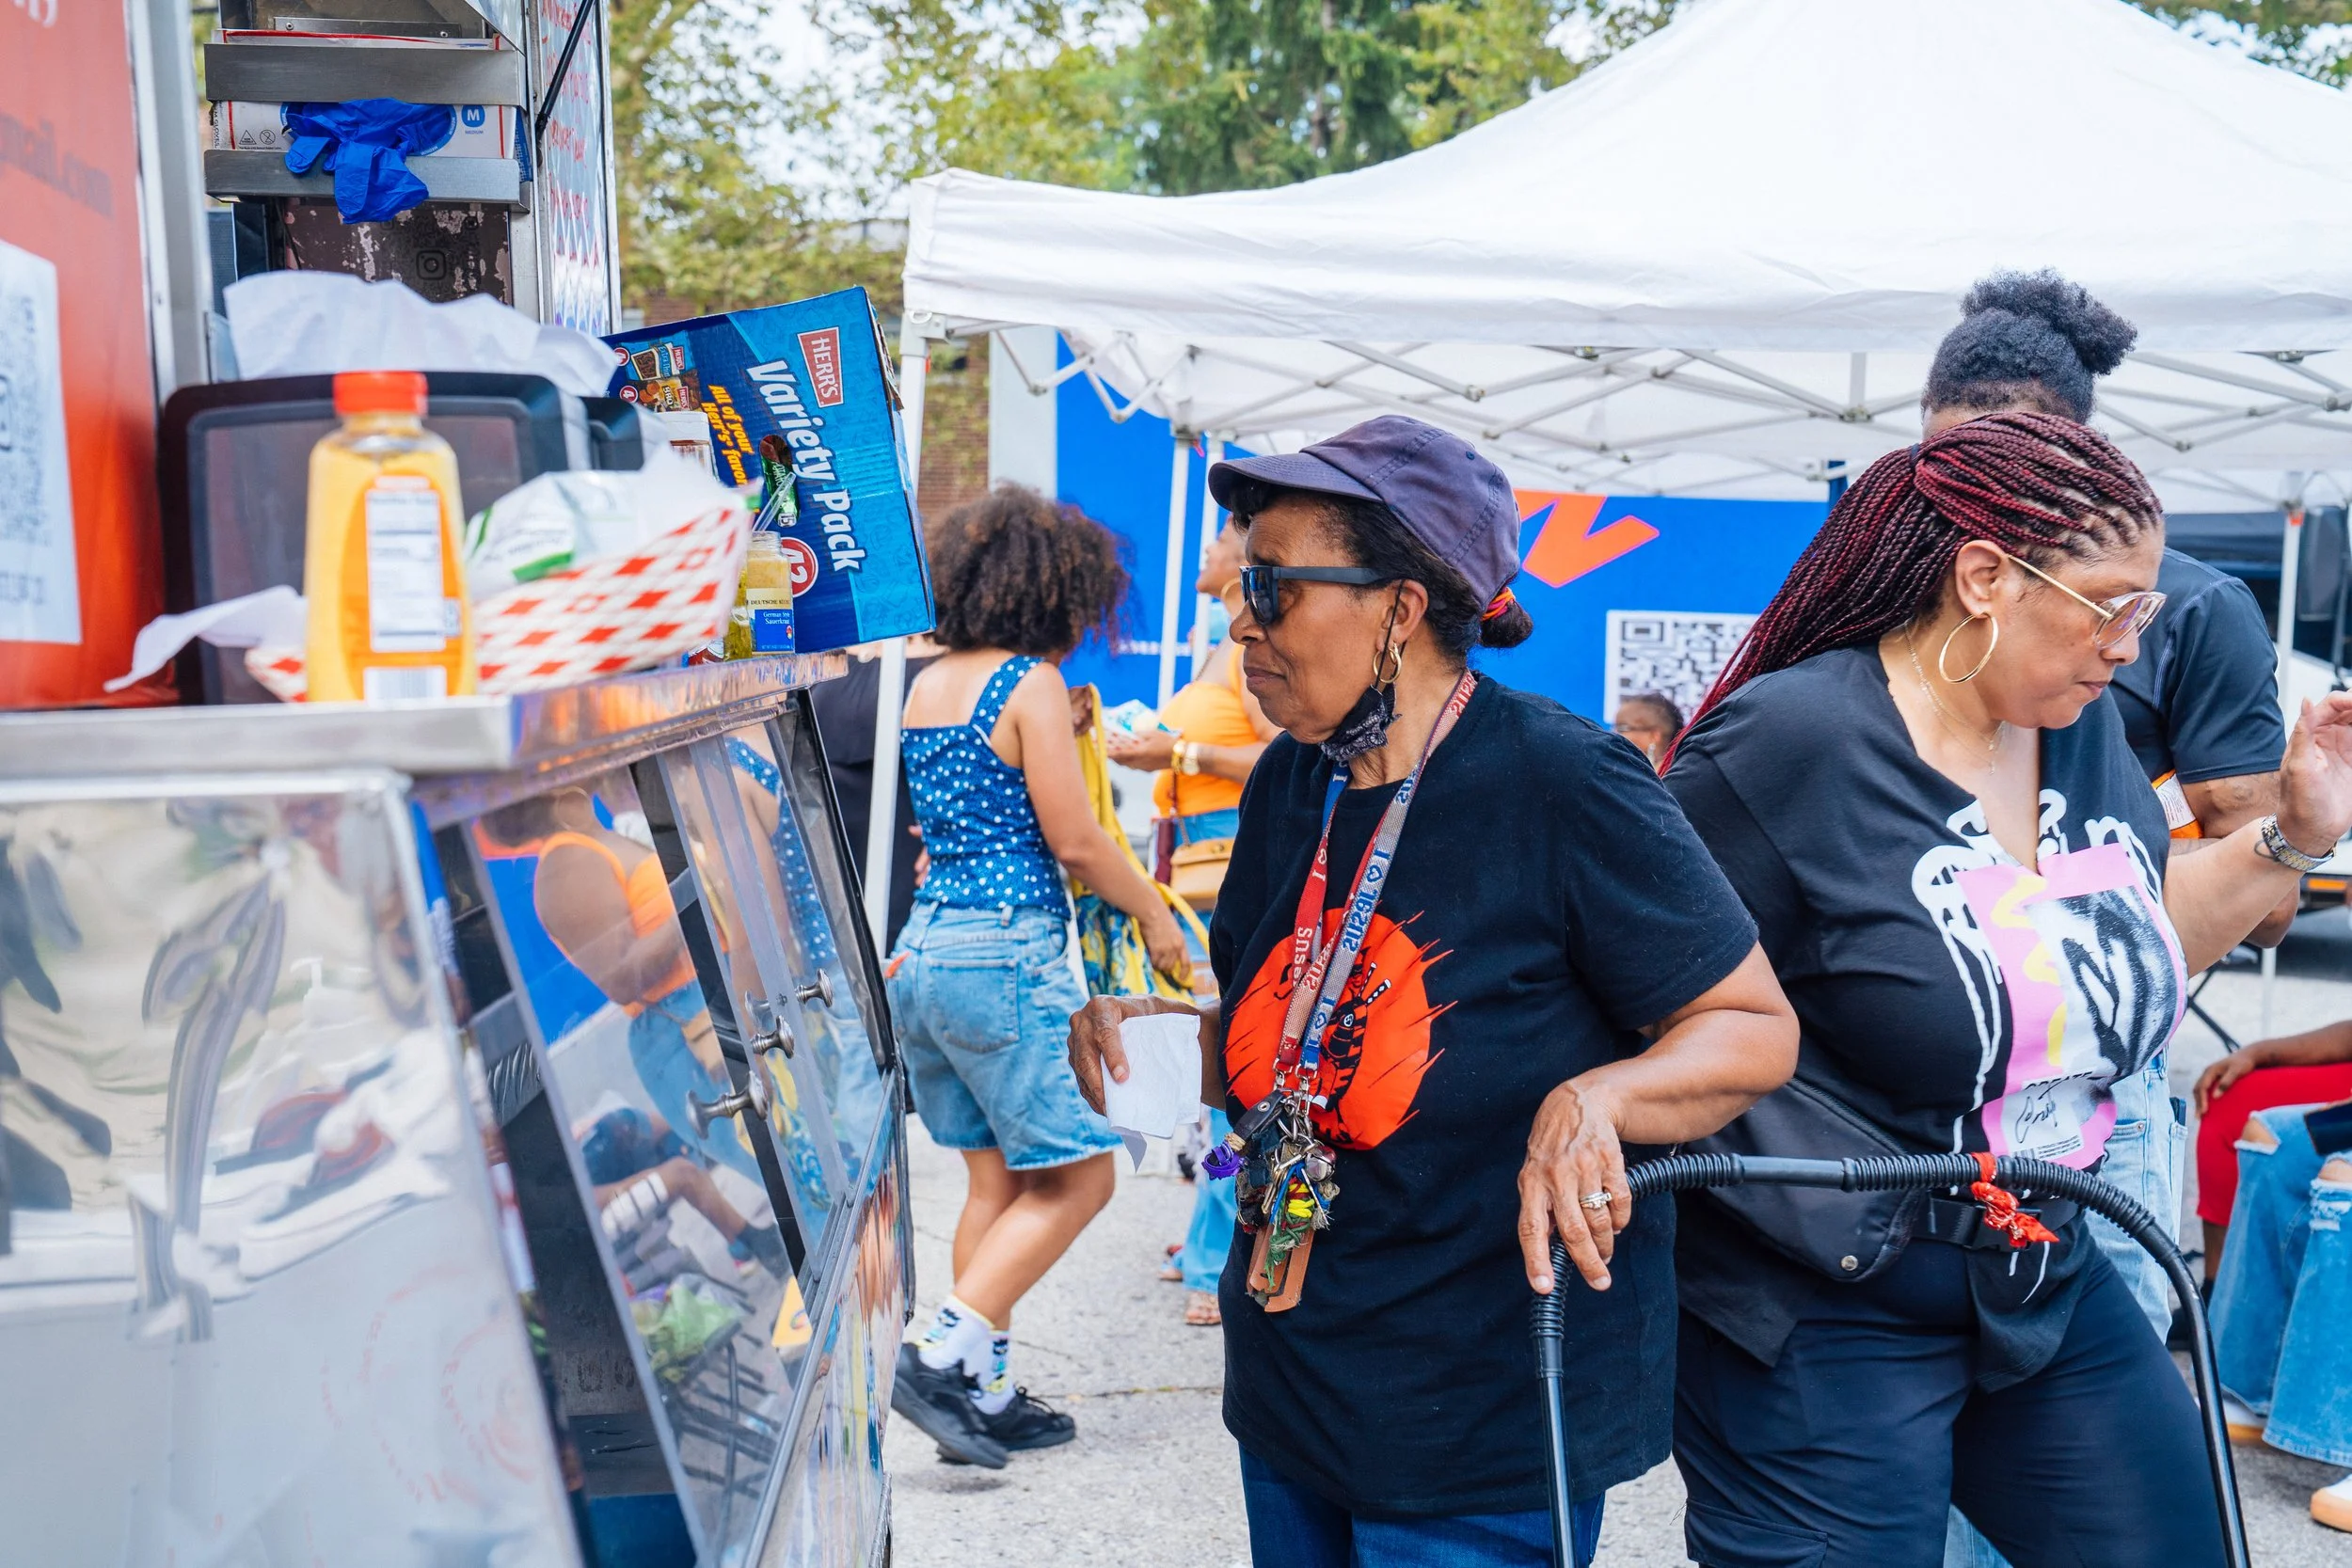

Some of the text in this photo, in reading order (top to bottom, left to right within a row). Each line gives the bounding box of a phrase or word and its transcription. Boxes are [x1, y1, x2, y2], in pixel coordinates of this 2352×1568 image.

[467, 109, 480, 121] M
[623, 389, 634, 399] 4
[811, 337, 838, 403] HERR'S
[708, 385, 755, 455] All of your
[722, 449, 750, 486] favor
[746, 359, 866, 572] Variety Pack
